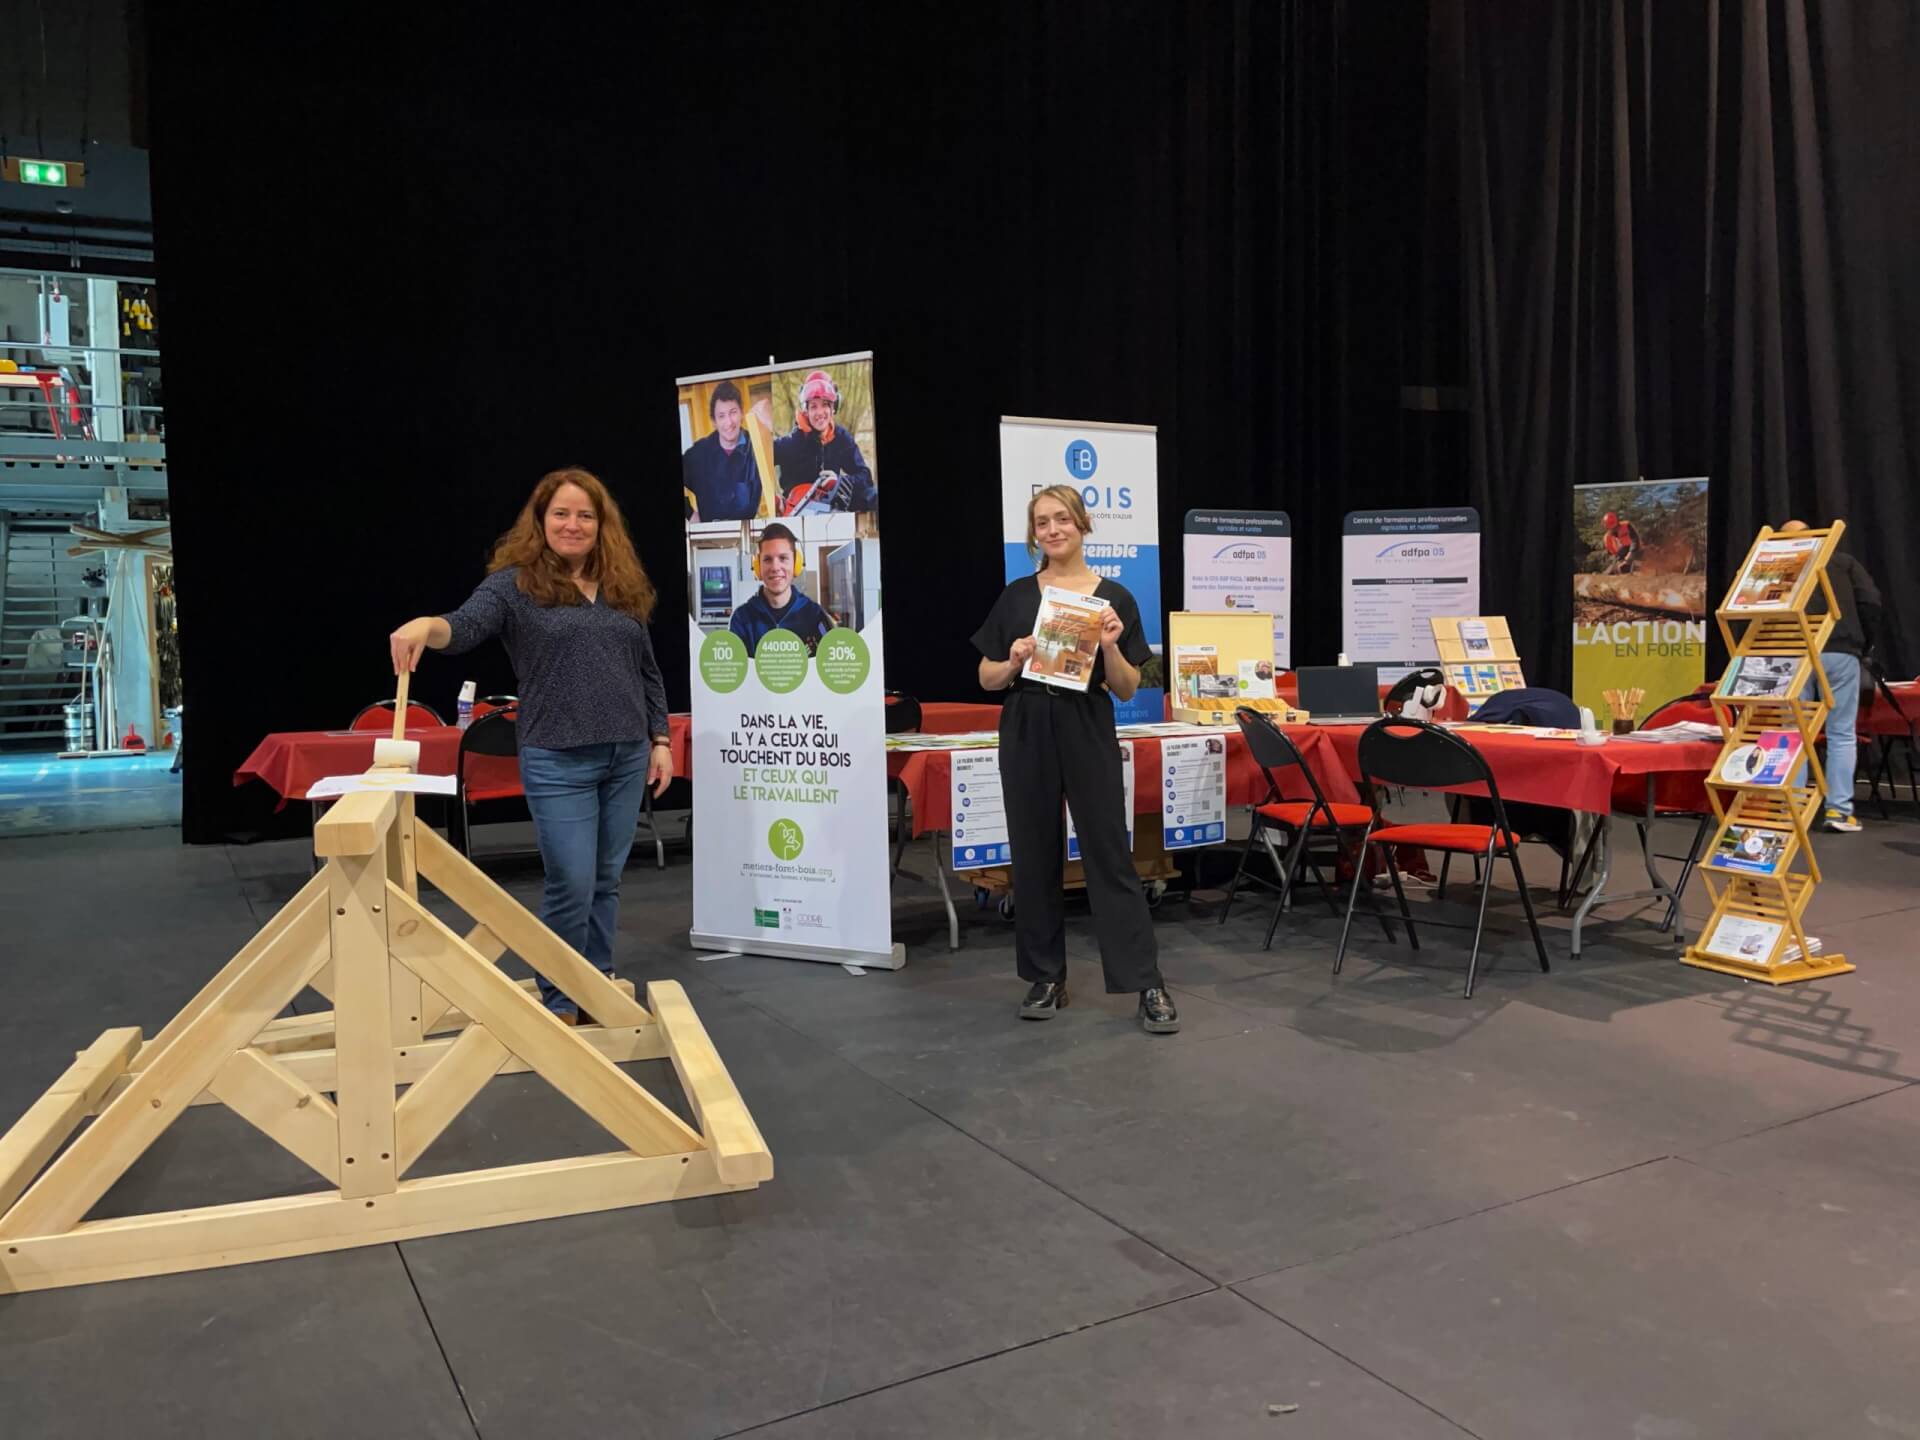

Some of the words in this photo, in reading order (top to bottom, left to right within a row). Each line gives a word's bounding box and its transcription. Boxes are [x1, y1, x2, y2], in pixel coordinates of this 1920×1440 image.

[1233, 549, 1255, 560] adfpa
[1401, 547, 1430, 558] adfpa
[1432, 547, 1445, 556] 05
[1573, 620, 1706, 645] L'ACTION
[712, 647, 733, 660] 100
[828, 646, 856, 660] 30%
[1615, 643, 1638, 657] EN
[1647, 639, 1705, 657] FORÊT
[741, 713, 775, 729] DANS
[779, 714, 797, 729] LA
[801, 714, 828, 731] VIE,
[731, 732, 742, 746] IL
[746, 732, 754, 745] Y
[758, 733, 767, 746] A
[771, 733, 808, 747] CEUX
[812, 733, 838, 748] QUI
[720, 749, 792, 765] TOUCHENT
[796, 751, 816, 766] DU
[820, 752, 851, 767] BOIS
[743, 768, 757, 782] ET
[761, 769, 797, 784] CEUX
[801, 770, 828, 785] QUI
[734, 786, 748, 800] LE
[750, 786, 839, 804] TRAVAILLENT
